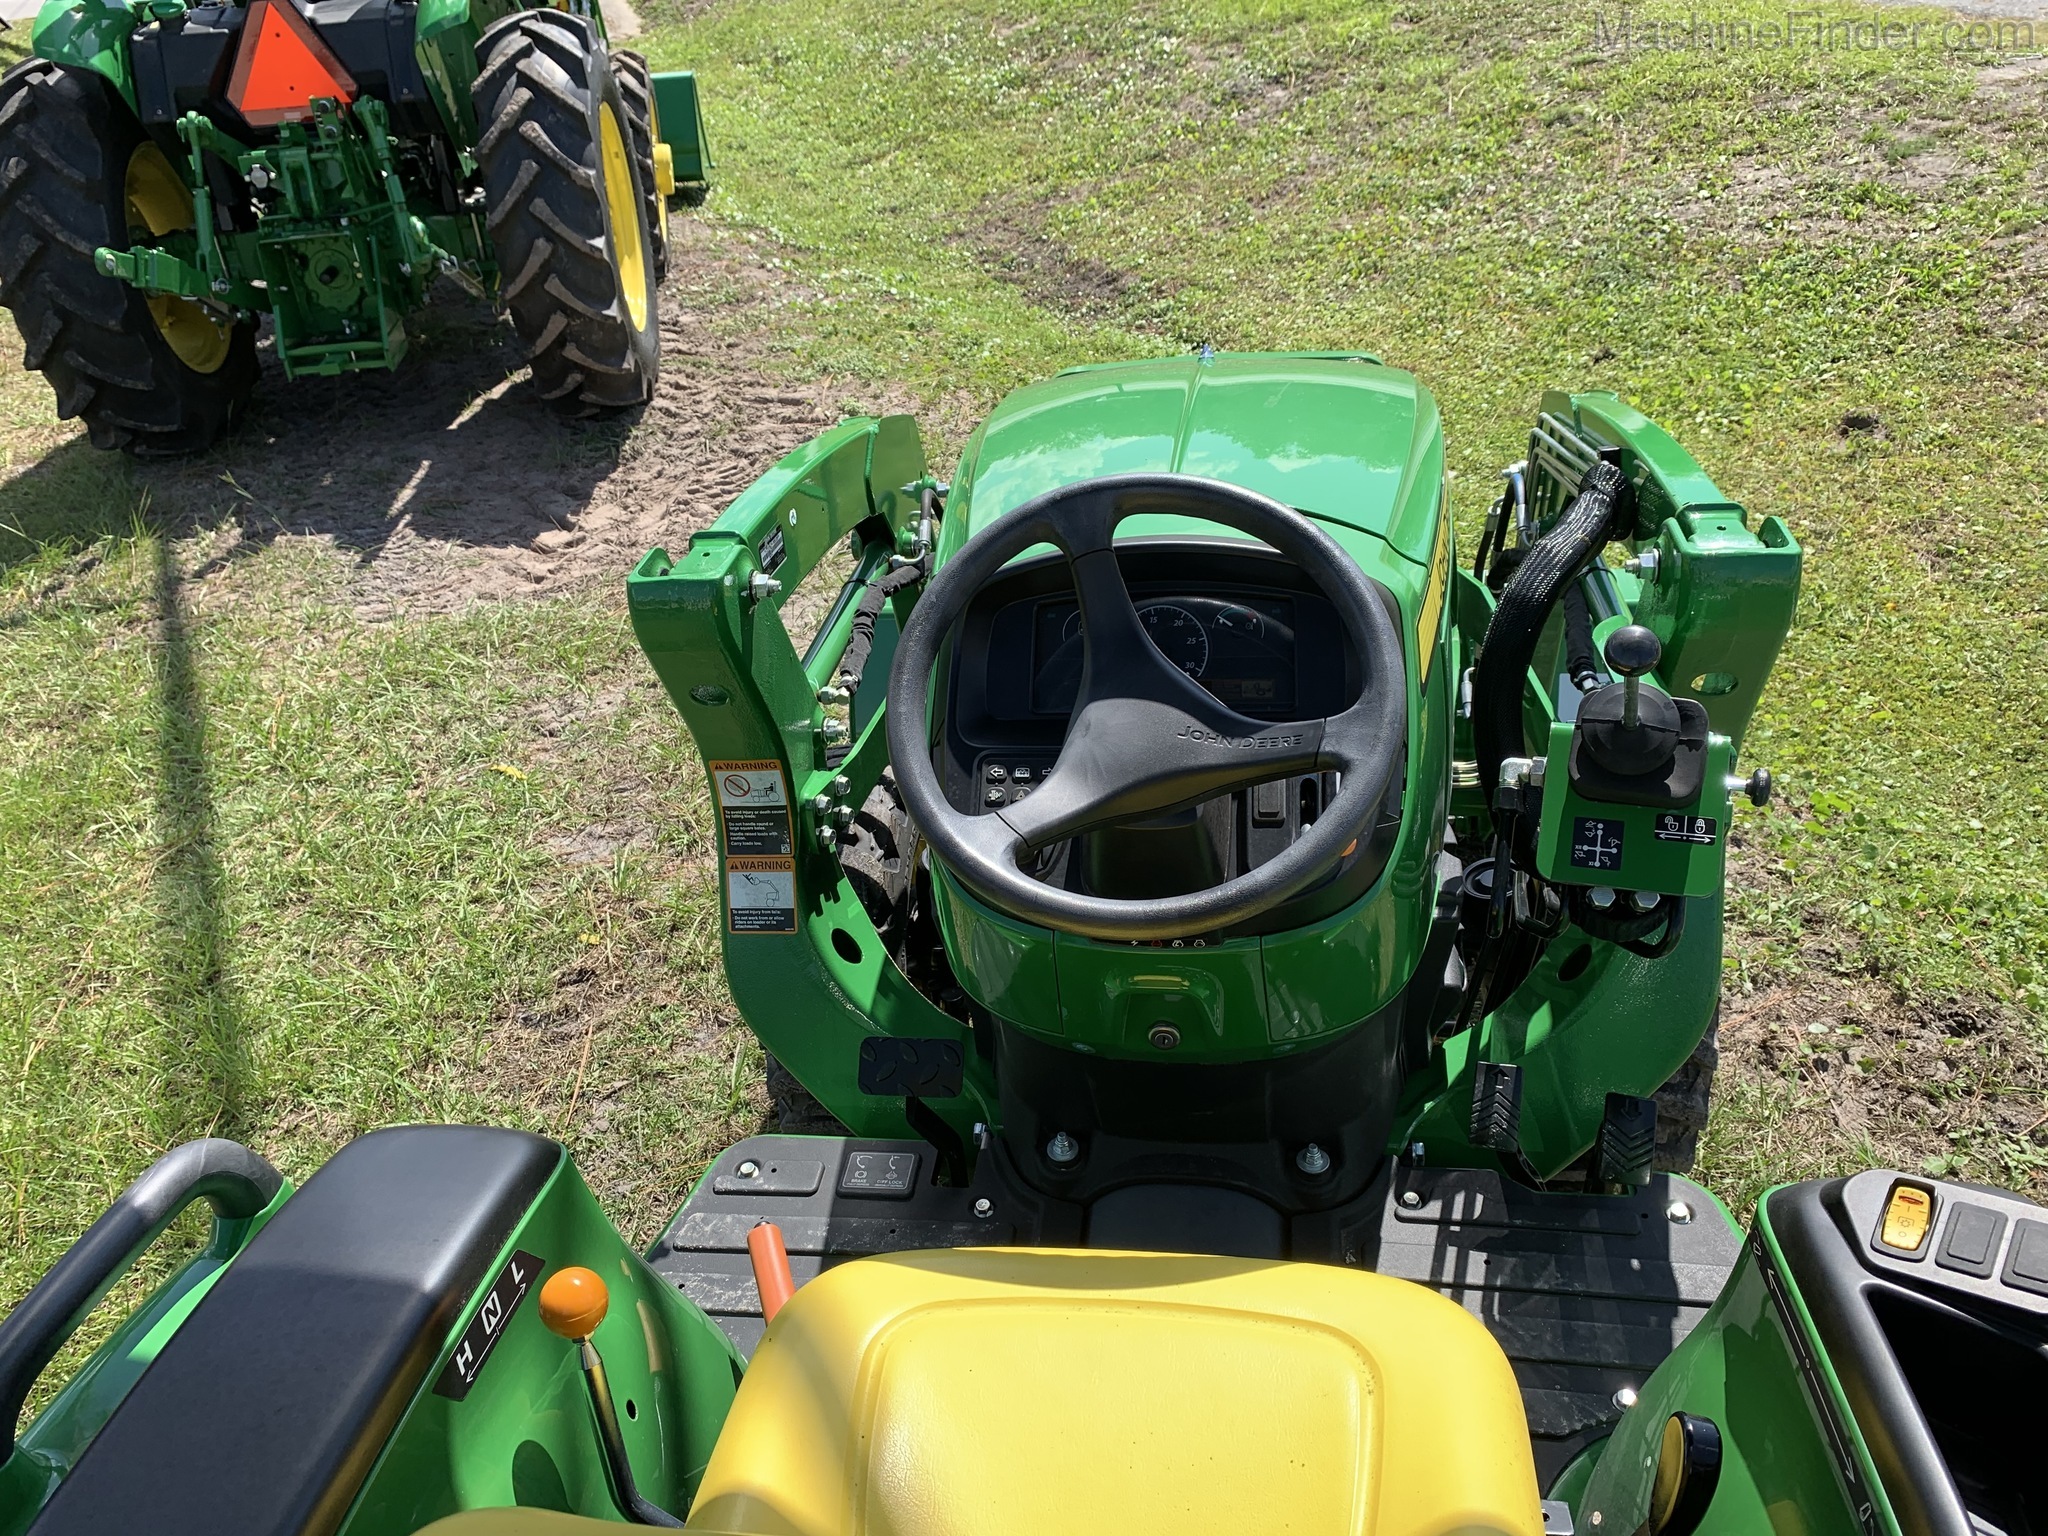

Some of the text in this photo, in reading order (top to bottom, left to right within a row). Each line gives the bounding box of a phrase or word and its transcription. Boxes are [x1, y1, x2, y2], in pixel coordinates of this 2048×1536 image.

[1149, 616, 1158, 624] 15
[1173, 619, 1184, 627] 20
[1186, 637, 1197, 645] 25
[1184, 661, 1195, 669] 30
[1177, 725, 1304, 750] JOHN DEERE
[723, 761, 778, 770] WARNING
[740, 861, 792, 870] WARNING
[456, 1340, 474, 1376] H
[511, 1261, 525, 1285] L
